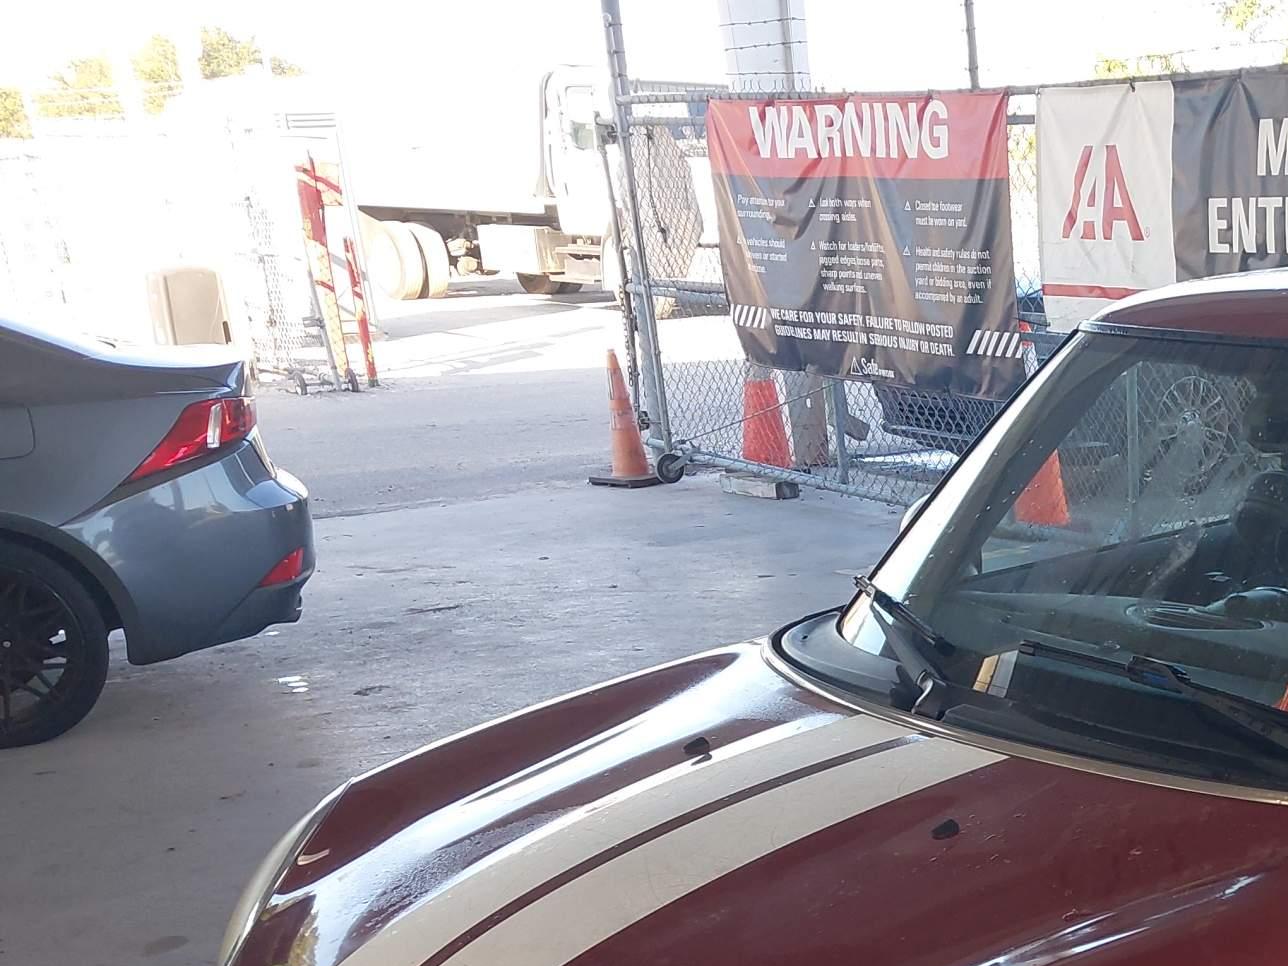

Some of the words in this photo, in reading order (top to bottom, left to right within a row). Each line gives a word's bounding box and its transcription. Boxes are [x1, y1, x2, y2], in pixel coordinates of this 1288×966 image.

[749, 100, 949, 159] WARNING
[940, 201, 962, 212] footwear
[948, 218, 954, 226] on
[819, 241, 837, 250] Watch
[819, 254, 839, 266] jagged
[978, 250, 990, 259] not
[821, 268, 837, 279] sharp
[956, 263, 965, 273] the
[967, 265, 992, 274] auction
[915, 276, 928, 287] yard
[770, 308, 781, 320] WE
[781, 309, 798, 322] CARE
[800, 311, 814, 323] FOR
[815, 312, 836, 325] YOUR
[838, 314, 864, 326] SAFETY.
[866, 316, 893, 330] FAILURE
[894, 319, 901, 330] TO
[902, 320, 925, 334] FOLLOW
[926, 324, 953, 338] POSTED
[775, 325, 812, 339] GUIDELINES
[813, 328, 831, 341] MAY
[832, 330, 857, 343] RESULT
[858, 332, 867, 344] IN
[869, 334, 897, 348] SERIOUS
[899, 337, 918, 352] INJURY
[920, 341, 929, 353] OR
[930, 342, 955, 357] DEATH.
